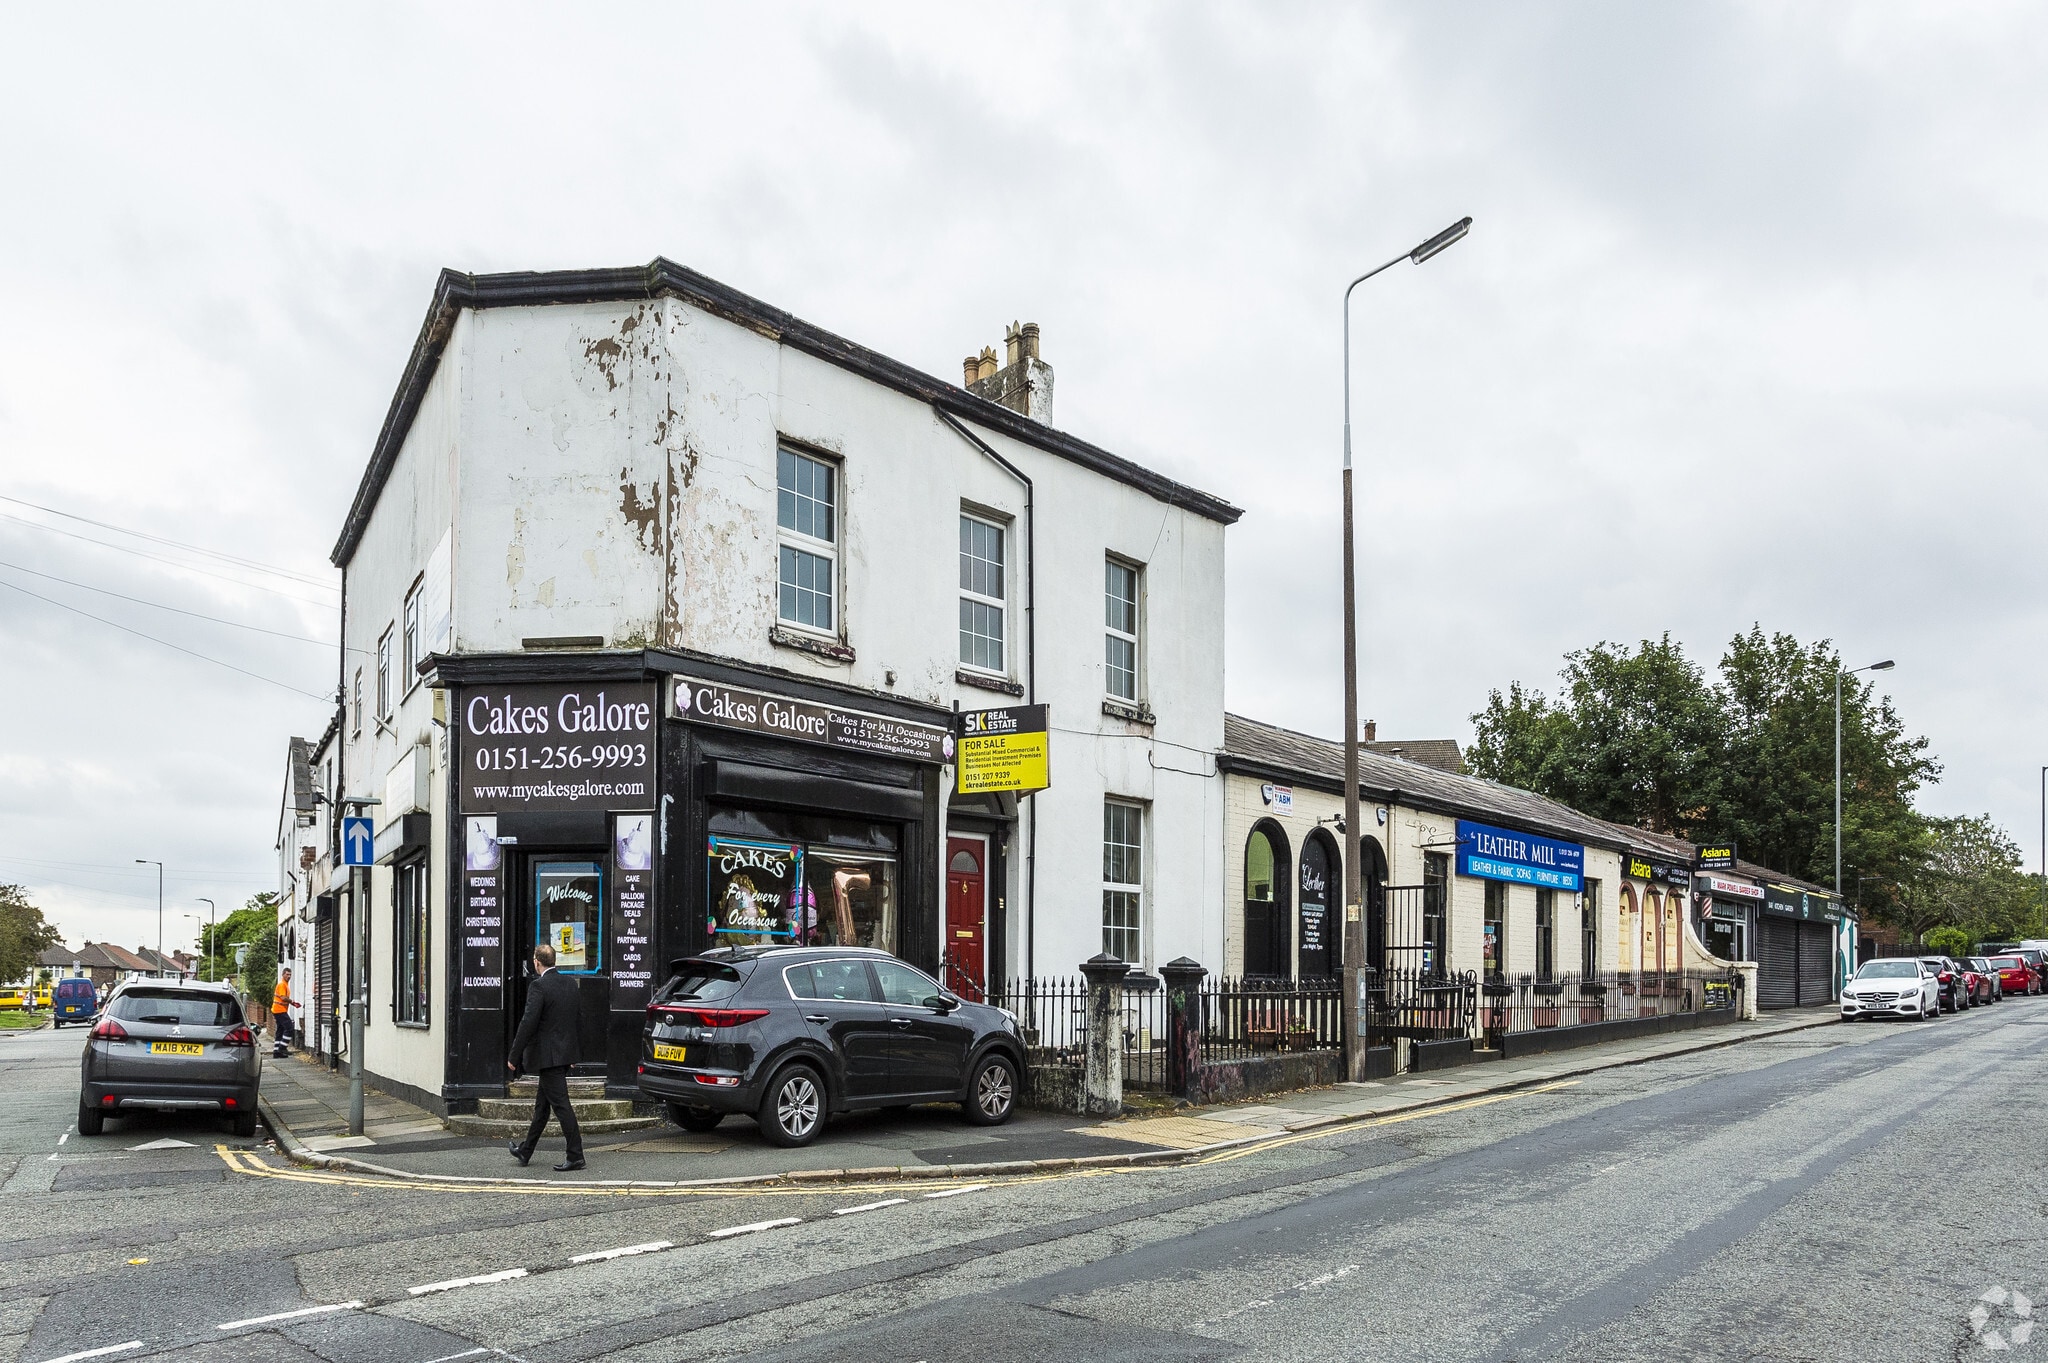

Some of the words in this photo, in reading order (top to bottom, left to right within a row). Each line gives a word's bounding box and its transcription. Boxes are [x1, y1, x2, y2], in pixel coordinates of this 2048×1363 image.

[466, 694, 548, 736] Cakes
[558, 692, 650, 733] Galore
[696, 688, 756, 724] Cakes
[762, 701, 825, 735] Galore
[828, 713, 858, 727] Cakes
[860, 718, 877, 730] For
[879, 722, 894, 734] All
[896, 726, 941, 742] Occasions
[965, 712, 987, 732] SK
[988, 711, 1009, 720] REAL
[988, 719, 1017, 730] ESTATE
[837, 735, 931, 758] www.mycakesgalore.com
[844, 727, 930, 749] 0151-256-9993
[965, 741, 981, 750] FOR
[984, 739, 1006, 748] SALE
[476, 744, 647, 770] 0151-256-9993
[995, 771, 1010, 779] 9339
[473, 779, 644, 802] www.mycakesgalore.com
[966, 779, 1021, 789] skrealestate.co.uk
[1279, 795, 1291, 805] ABM
[1477, 833, 1527, 860] LEATHER
[1531, 844, 1556, 866] MILL
[1701, 848, 1730, 858] Asiana
[720, 849, 786, 878] CAKES
[1630, 858, 1651, 878] Asiana
[470, 877, 496, 886] WEDDINGS
[1472, 860, 1491, 873] LEATHER
[1493, 865, 1496, 874] &
[1498, 866, 1513, 878] FABRIC
[1517, 868, 1531, 880] SOFAS
[1537, 871, 1558, 883] FURNITURE
[1563, 876, 1572, 886] BEDS
[546, 882, 593, 903] Welcome
[726, 882, 747, 900] For
[752, 891, 780, 908] every
[470, 897, 496, 906] BIRTHDAYS
[466, 917, 500, 927] CHRISTENINGS
[729, 910, 778, 927] Occasion
[466, 937, 499, 947] COMMUNIONS
[480, 957, 484, 967] &
[464, 977, 473, 986] ALL
[473, 977, 500, 986] OCCASIONS
[613, 971, 651, 979] PERSONALISED
[155, 1044, 177, 1052] MA18
[180, 1045, 199, 1053] XMZ
